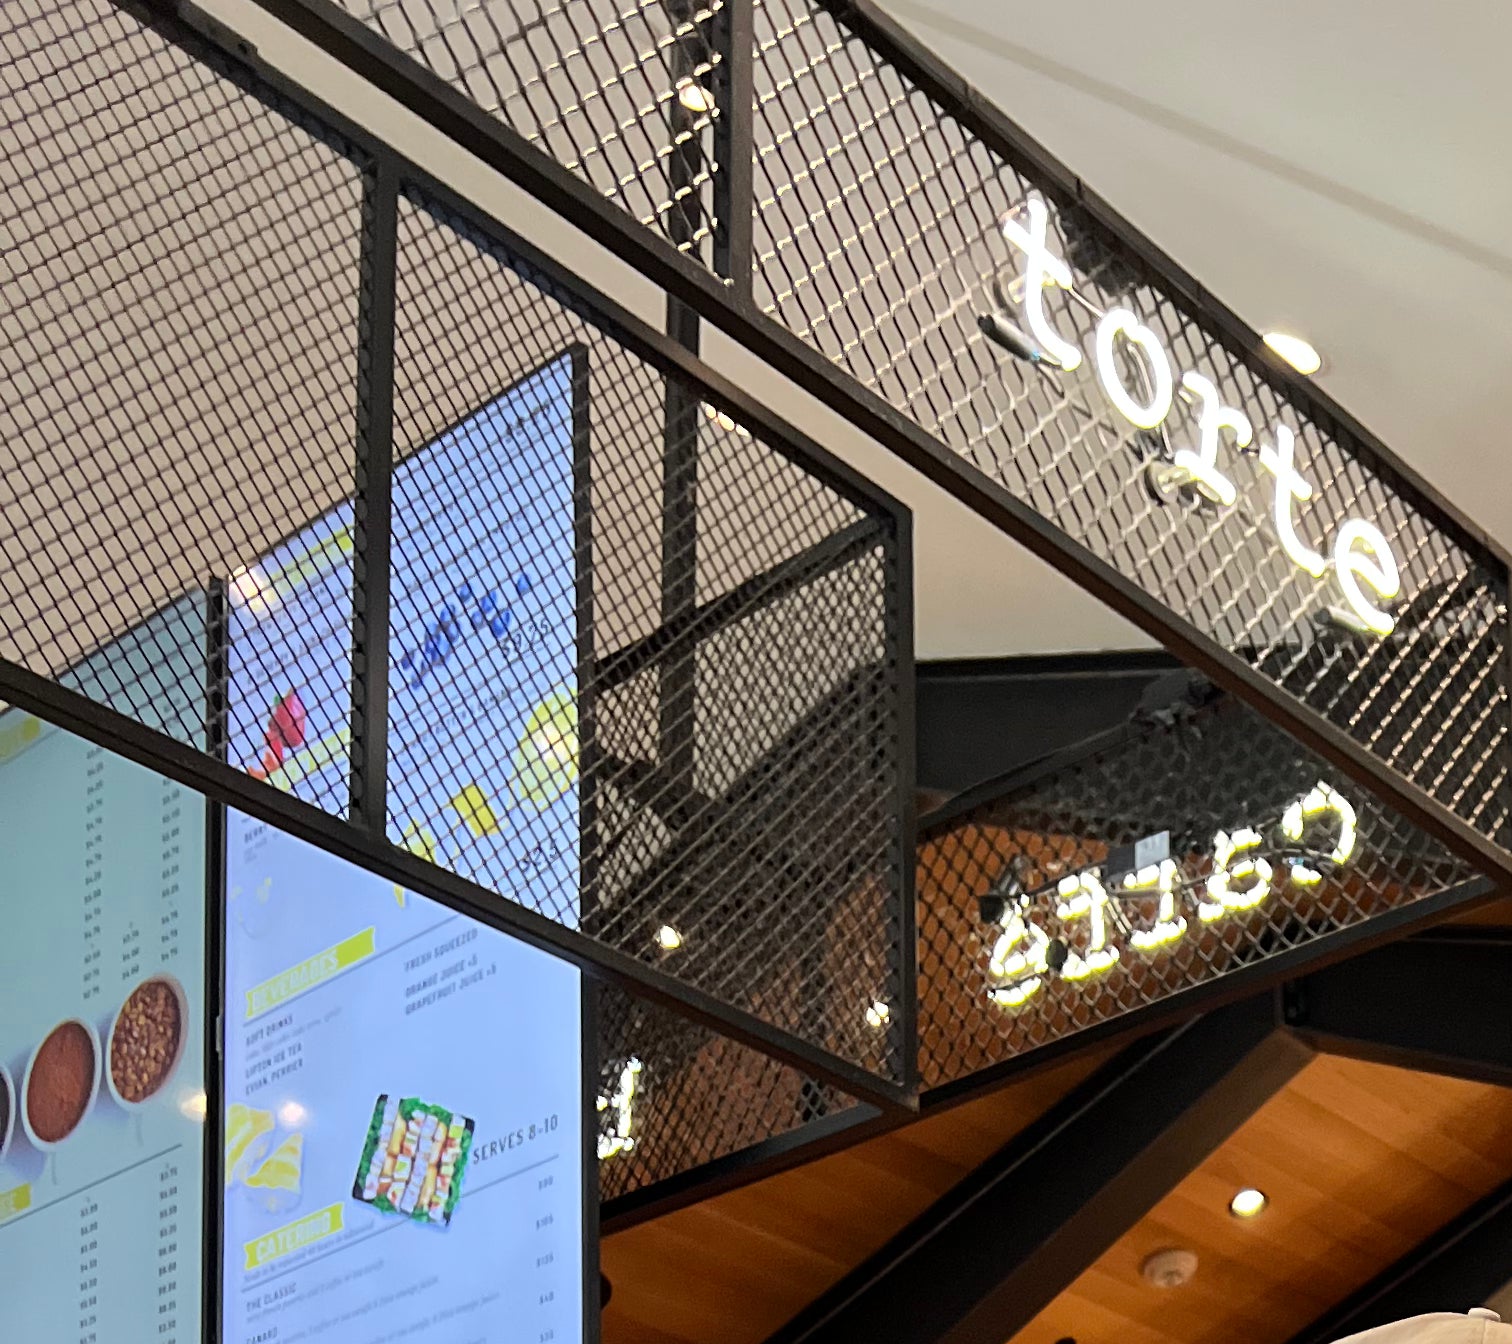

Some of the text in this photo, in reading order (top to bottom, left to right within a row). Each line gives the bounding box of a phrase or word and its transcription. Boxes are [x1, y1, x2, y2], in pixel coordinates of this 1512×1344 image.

[473, 1114, 558, 1165] SERVES 8-10
[246, 1296, 261, 1313] THE
[264, 1282, 297, 1305] CLASSIC
